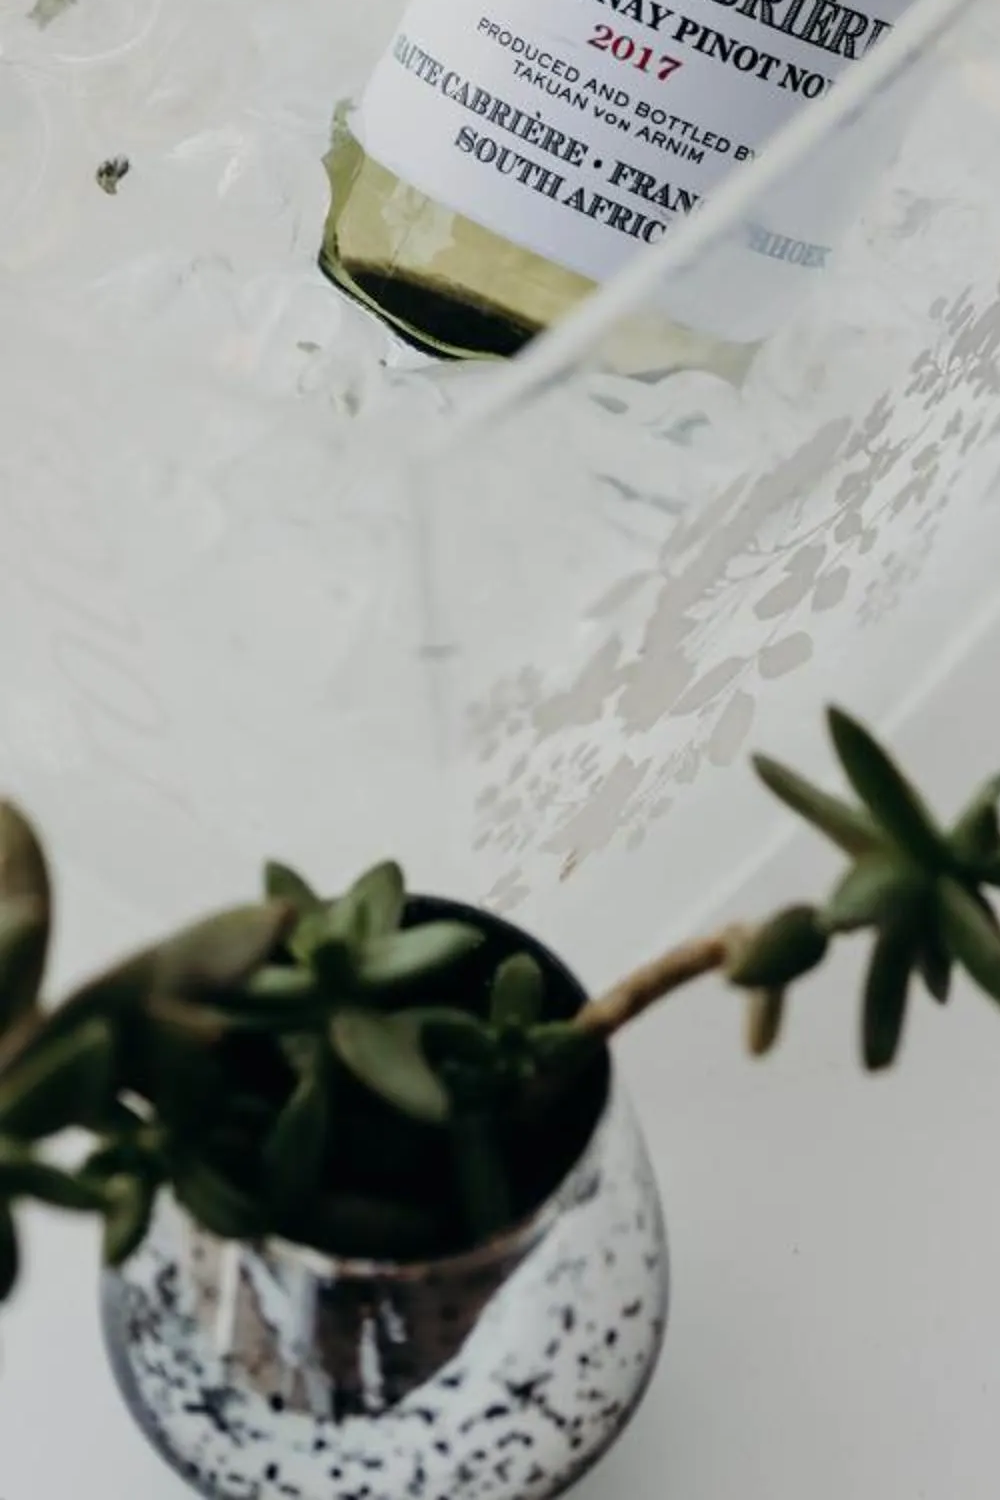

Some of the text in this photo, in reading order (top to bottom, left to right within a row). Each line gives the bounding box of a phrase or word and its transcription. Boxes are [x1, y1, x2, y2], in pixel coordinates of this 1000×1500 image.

[477, 17, 580, 83] PRODUCED
[584, 78, 630, 108] AND
[635, 101, 731, 153] BOTTLED
[586, 24, 684, 82] 2017
[671, 17, 781, 85] PINOT
[441, 71, 589, 167] CABRIÈRE
[512, 60, 589, 110] TAKUAN
[635, 126, 705, 165] ARNIM
[454, 125, 667, 245] SOUTH AFRIC
